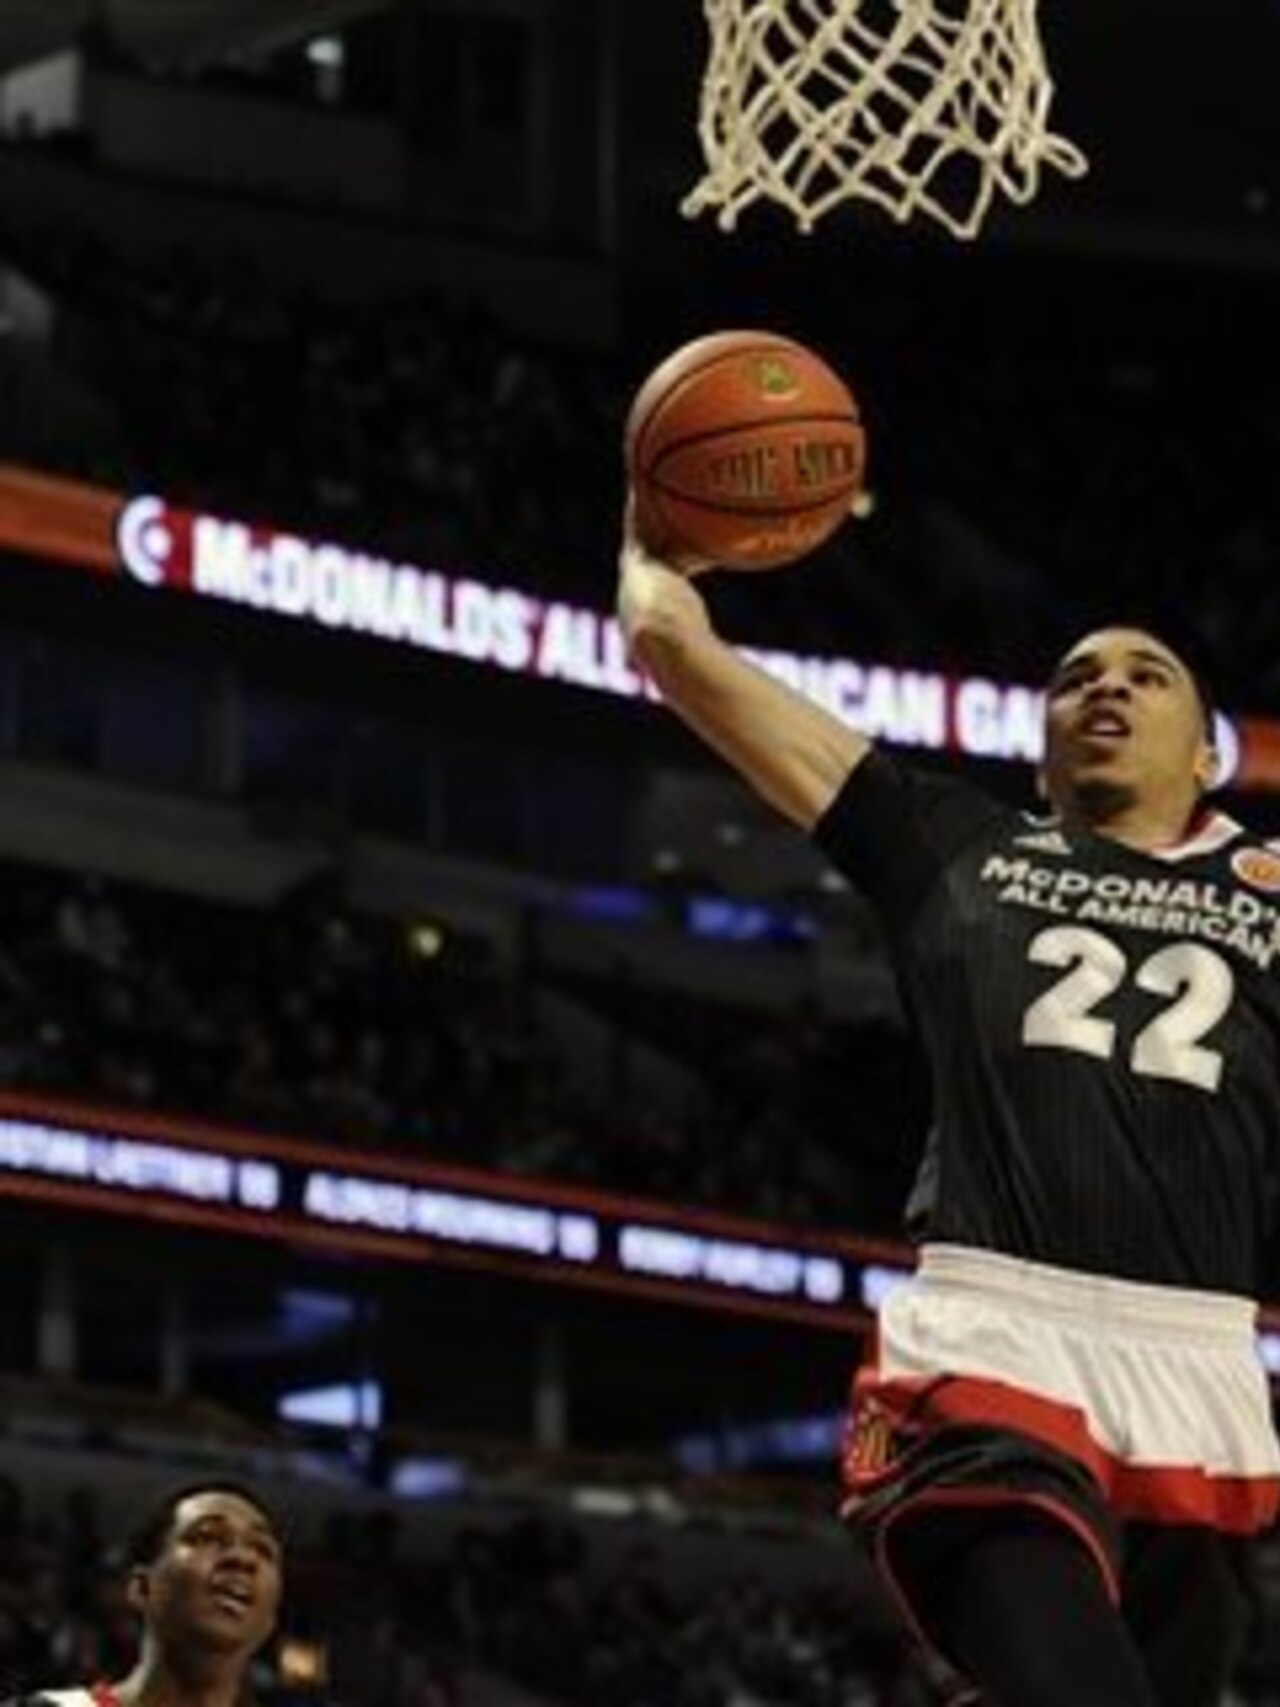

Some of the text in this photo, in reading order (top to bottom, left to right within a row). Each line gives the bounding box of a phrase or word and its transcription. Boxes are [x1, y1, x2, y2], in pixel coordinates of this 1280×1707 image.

[537, 602, 641, 697] ALL
[999, 883, 1071, 915] ALL
[1022, 923, 1235, 1093] 22
